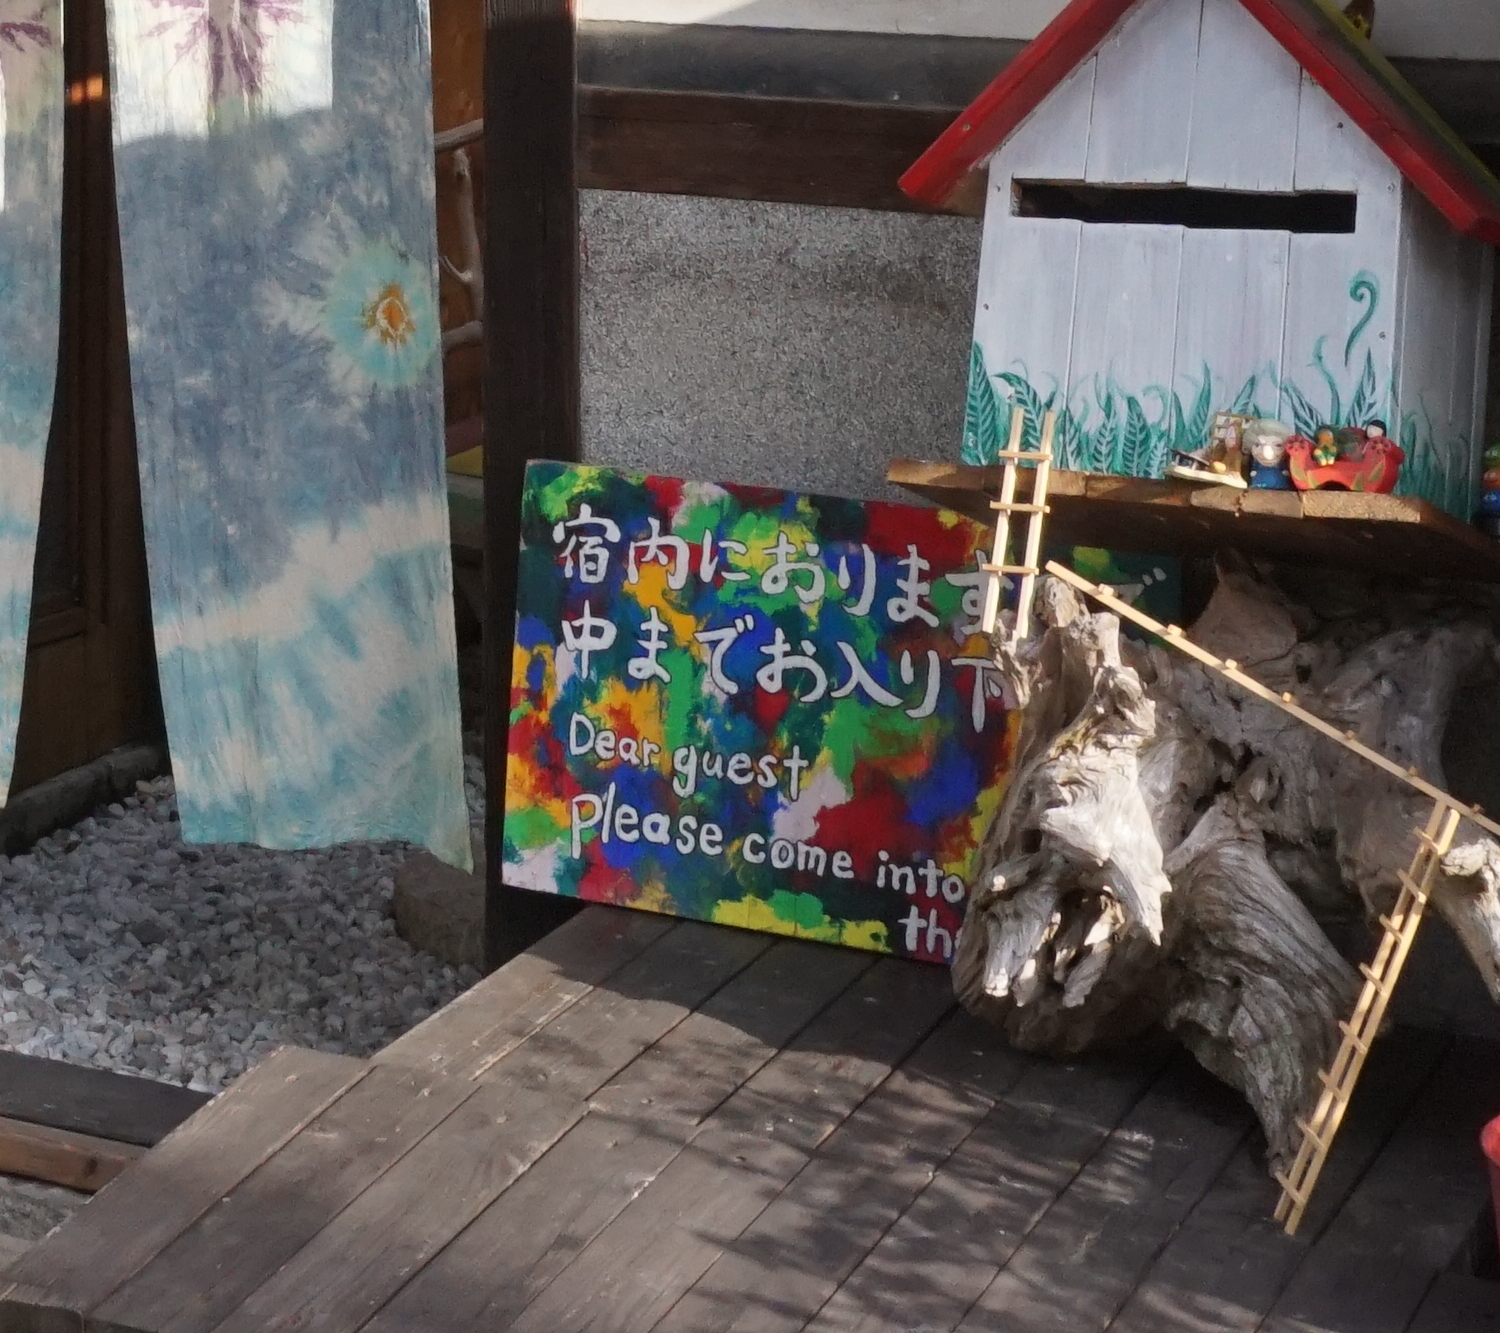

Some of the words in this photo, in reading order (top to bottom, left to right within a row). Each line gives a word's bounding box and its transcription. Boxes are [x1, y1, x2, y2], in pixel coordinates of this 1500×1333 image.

[568, 711, 660, 769] Dear
[672, 744, 810, 803] guest
[742, 836, 855, 881] come
[877, 850, 965, 903] into
[898, 905, 962, 958] th
